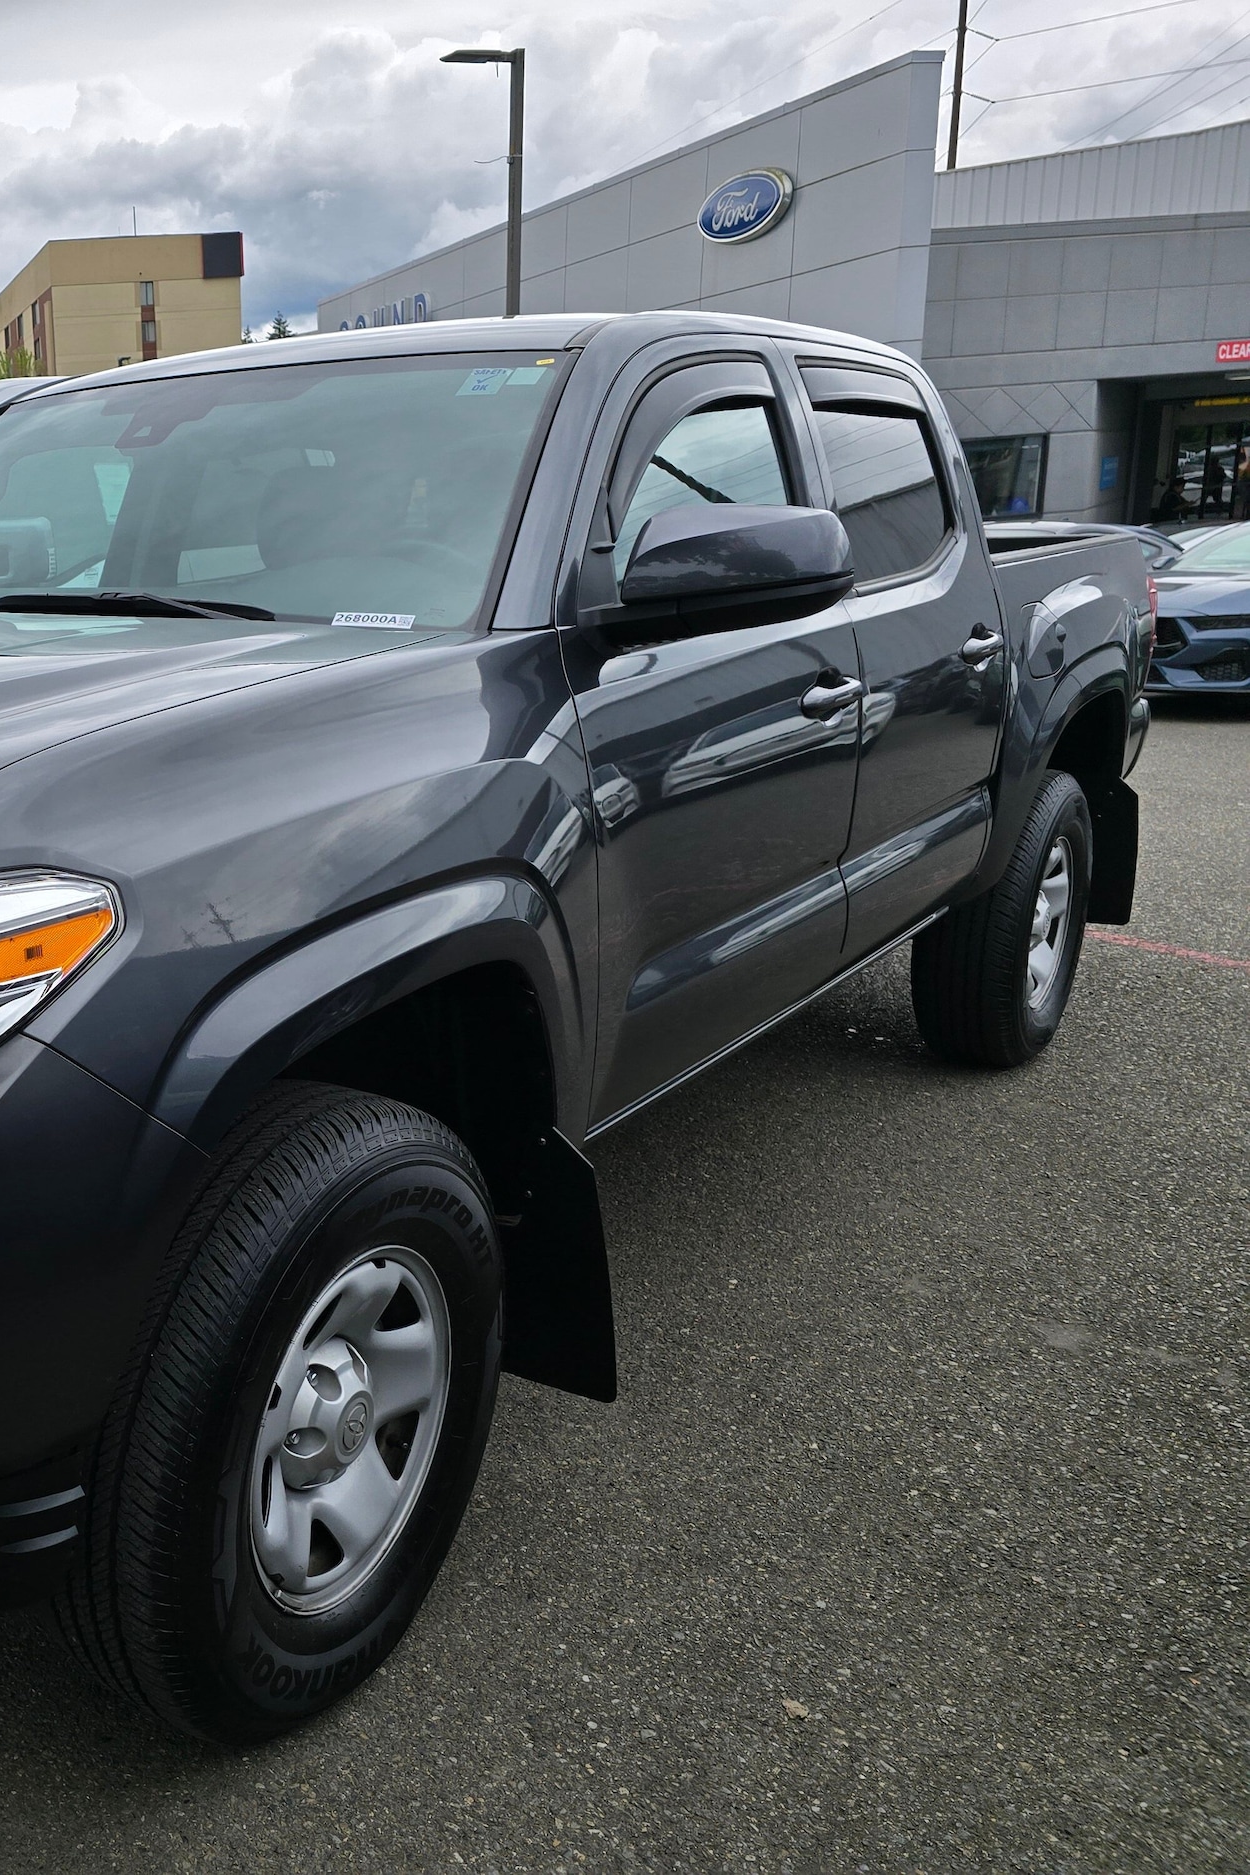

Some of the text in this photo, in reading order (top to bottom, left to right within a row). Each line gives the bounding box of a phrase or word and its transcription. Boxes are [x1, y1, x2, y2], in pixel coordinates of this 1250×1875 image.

[711, 187, 761, 232] Ford
[473, 368, 507, 376] SAFETY
[335, 613, 398, 625] 268000A
